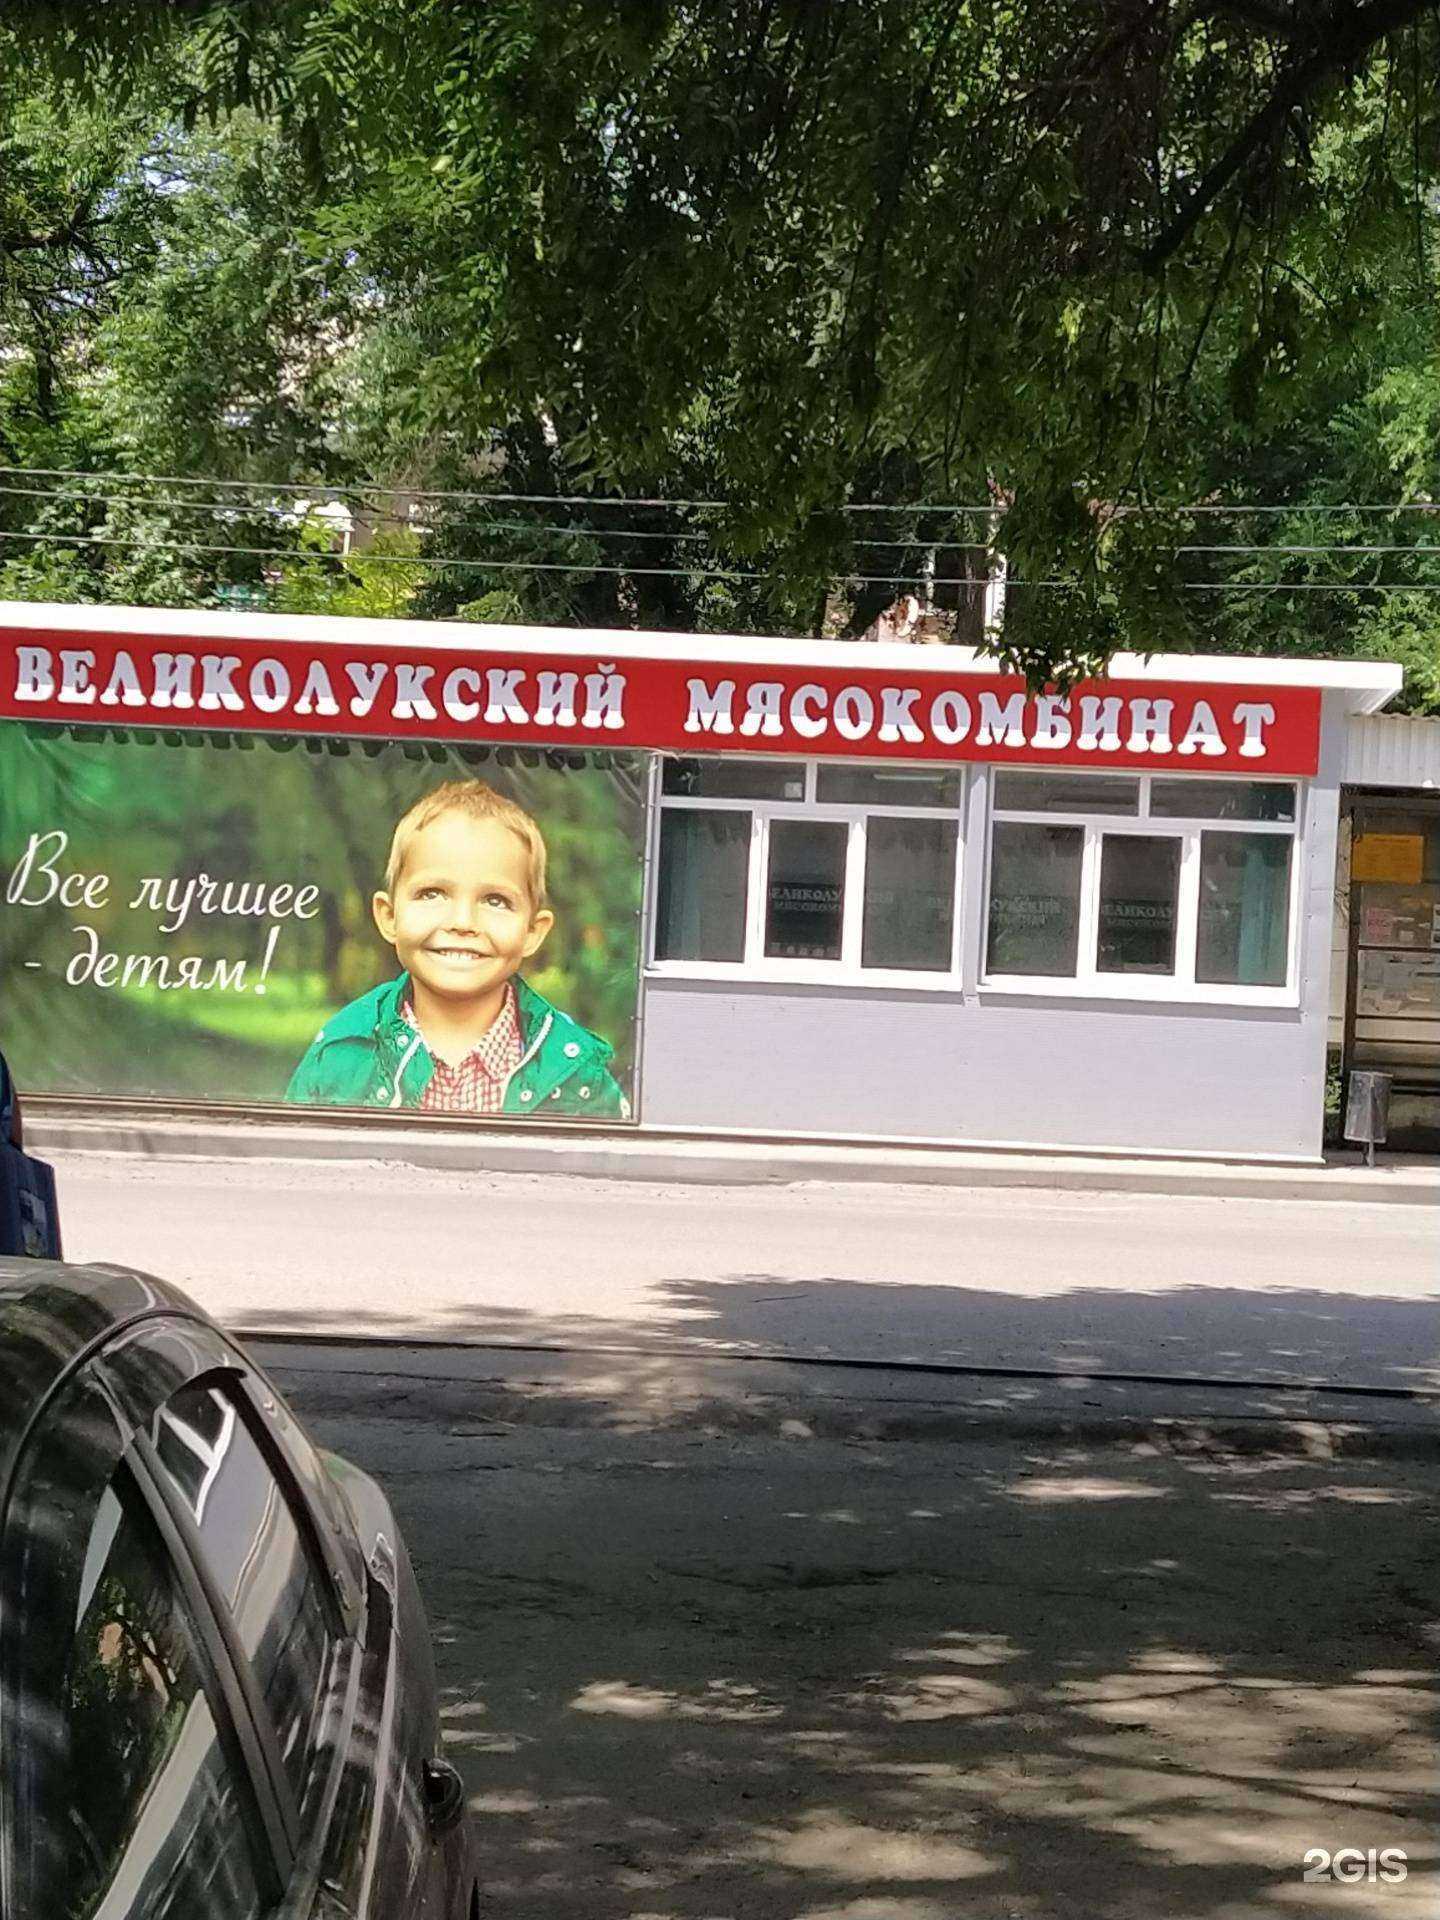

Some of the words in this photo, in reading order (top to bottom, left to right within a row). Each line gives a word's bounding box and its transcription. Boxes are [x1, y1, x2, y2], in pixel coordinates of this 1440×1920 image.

[13, 646, 628, 731] ВЕЛИКОЛУКСКИЙ
[683, 678, 1276, 759] МЯСОКОМБИНАТ
[6, 830, 110, 909] Все
[128, 873, 321, 932] лучшее
[65, 925, 281, 995] детям!
